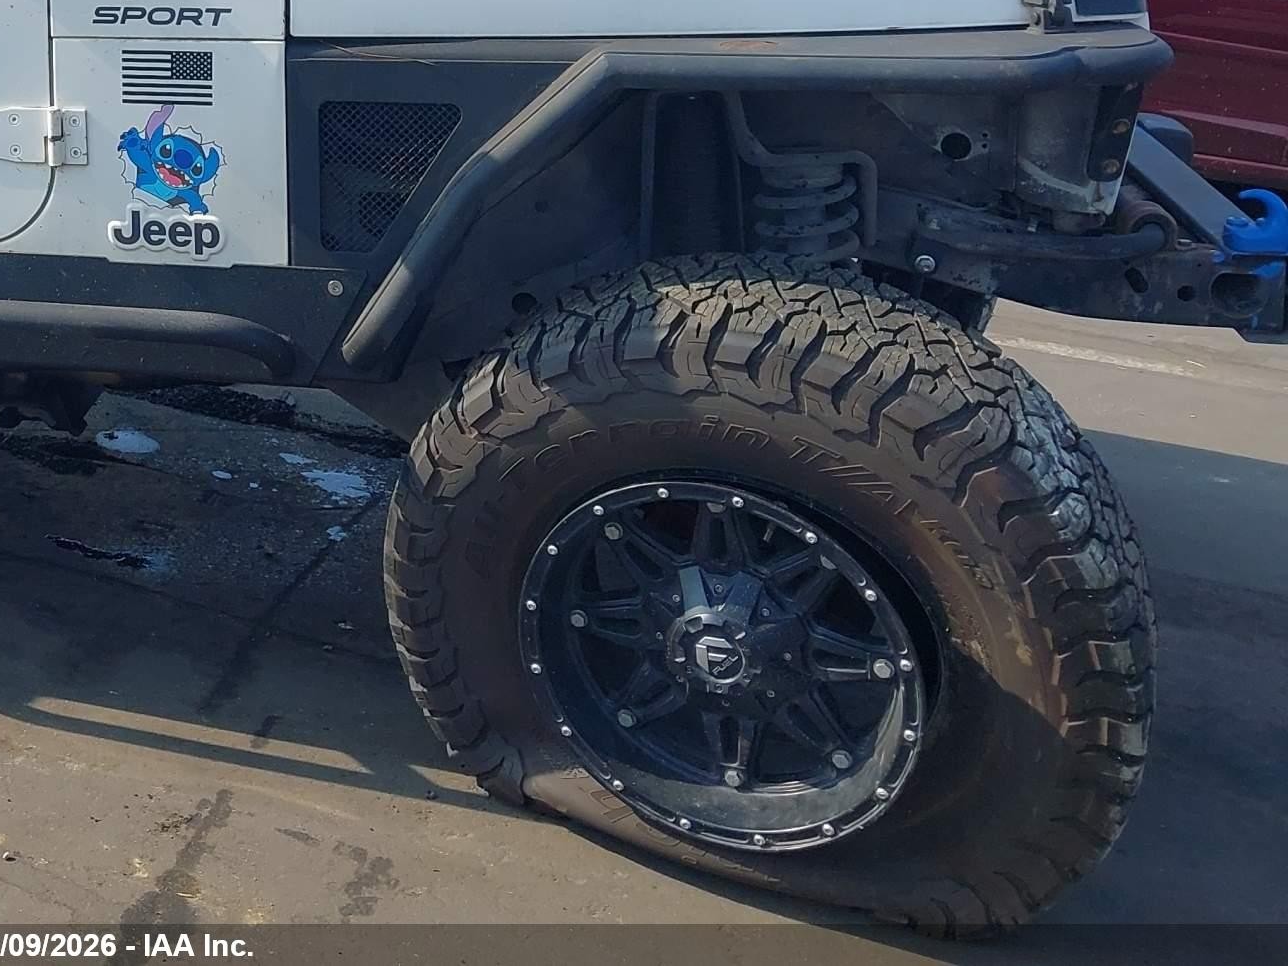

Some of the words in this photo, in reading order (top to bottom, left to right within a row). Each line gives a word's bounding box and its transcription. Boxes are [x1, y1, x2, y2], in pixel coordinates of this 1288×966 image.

[92, 6, 233, 27] SPORT
[114, 210, 220, 255] Jeep
[711, 655, 740, 676] FUEL
